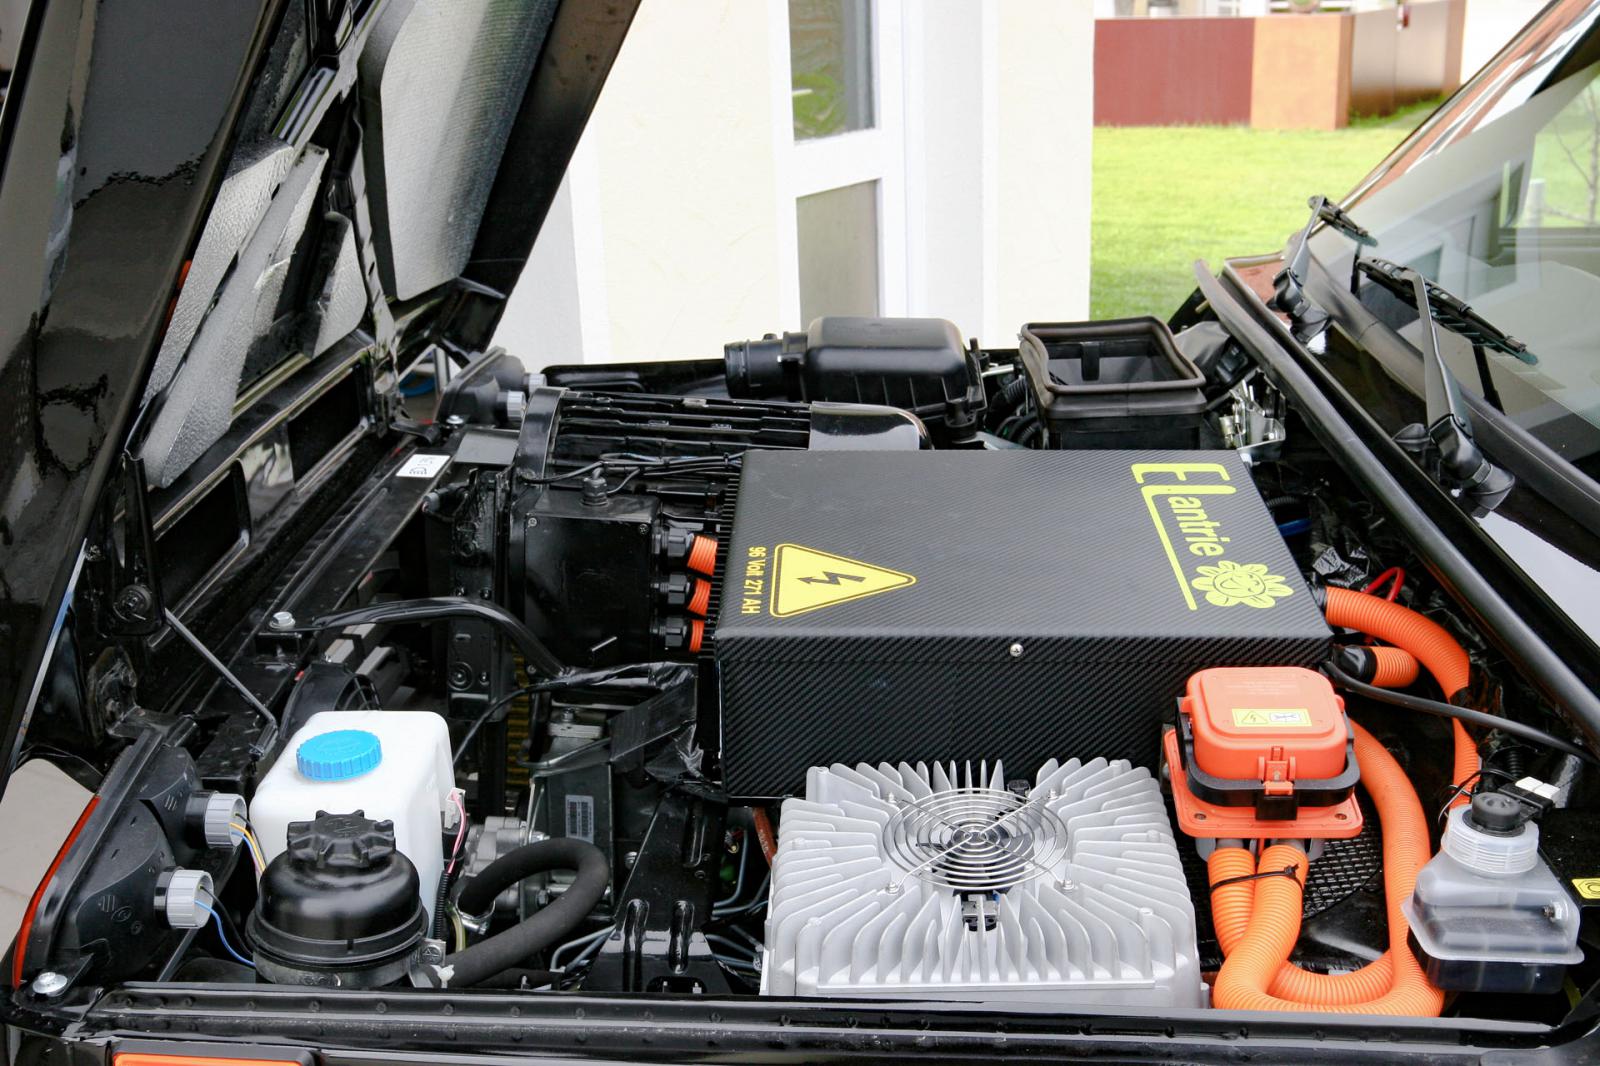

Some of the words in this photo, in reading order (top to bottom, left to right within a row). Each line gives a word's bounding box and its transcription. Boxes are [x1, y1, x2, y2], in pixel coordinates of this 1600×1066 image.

[747, 546, 767, 558] 96
[746, 559, 766, 577] Volt
[743, 579, 764, 595] 271
[741, 598, 762, 614] AH
